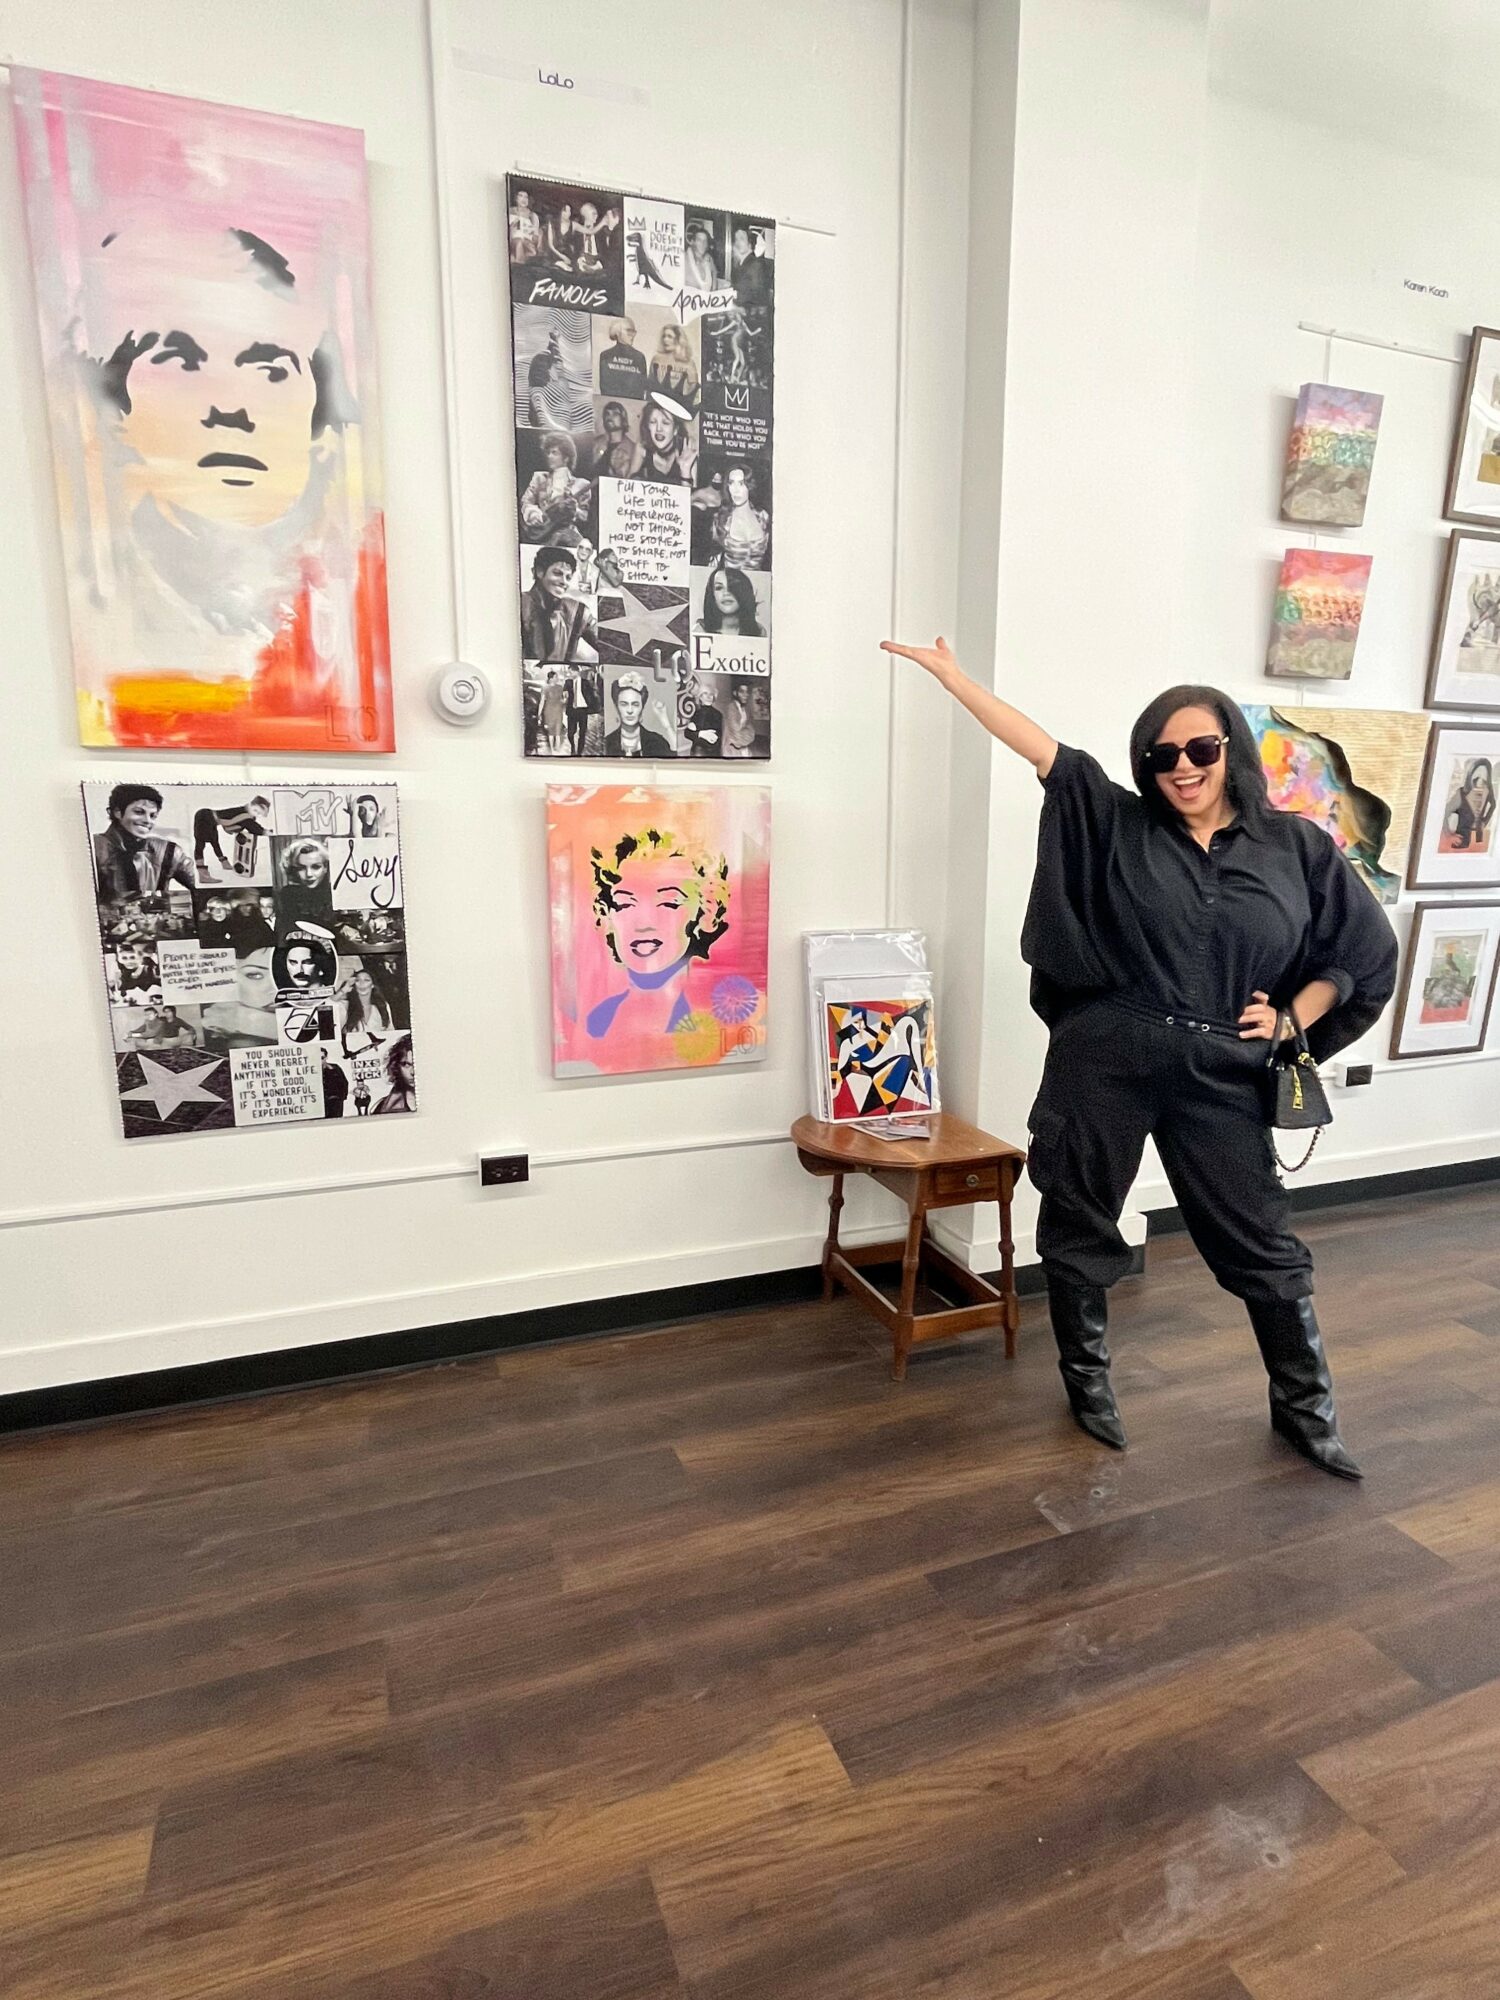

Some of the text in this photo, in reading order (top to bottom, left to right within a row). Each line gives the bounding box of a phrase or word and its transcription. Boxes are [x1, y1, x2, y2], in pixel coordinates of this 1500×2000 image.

[538, 68, 574, 89] LoLo
[654, 220, 677, 237] LIFE
[661, 253, 680, 267] ME
[529, 278, 608, 307] FAMOUS
[672, 289, 734, 324] power
[613, 356, 633, 365] ANDY
[608, 363, 641, 374] WARHOL
[736, 416, 751, 425] WHO
[716, 422, 731, 430] THAT
[733, 425, 753, 433] HOLDS
[736, 433, 751, 441] WHO
[625, 522, 644, 532] NOT
[693, 635, 767, 673] Exotic
[273, 790, 343, 836] MTV
[284, 1005, 336, 1043] 54
[246, 1047, 302, 1060] YOU SHOULD
[241, 1057, 308, 1070] NEVER REGRET
[353, 1060, 380, 1068] INXS
[234, 1069, 275, 1080] ANYTHING
[282, 1068, 290, 1077] IN
[353, 1071, 380, 1080] KICK
[246, 1081, 254, 1089] IF
[261, 1079, 277, 1088] IT'S
[240, 1091, 256, 1100] IT'S
[240, 1101, 247, 1109] IF
[255, 1099, 271, 1108] IT'S
[301, 1095, 317, 1104] IT'S
